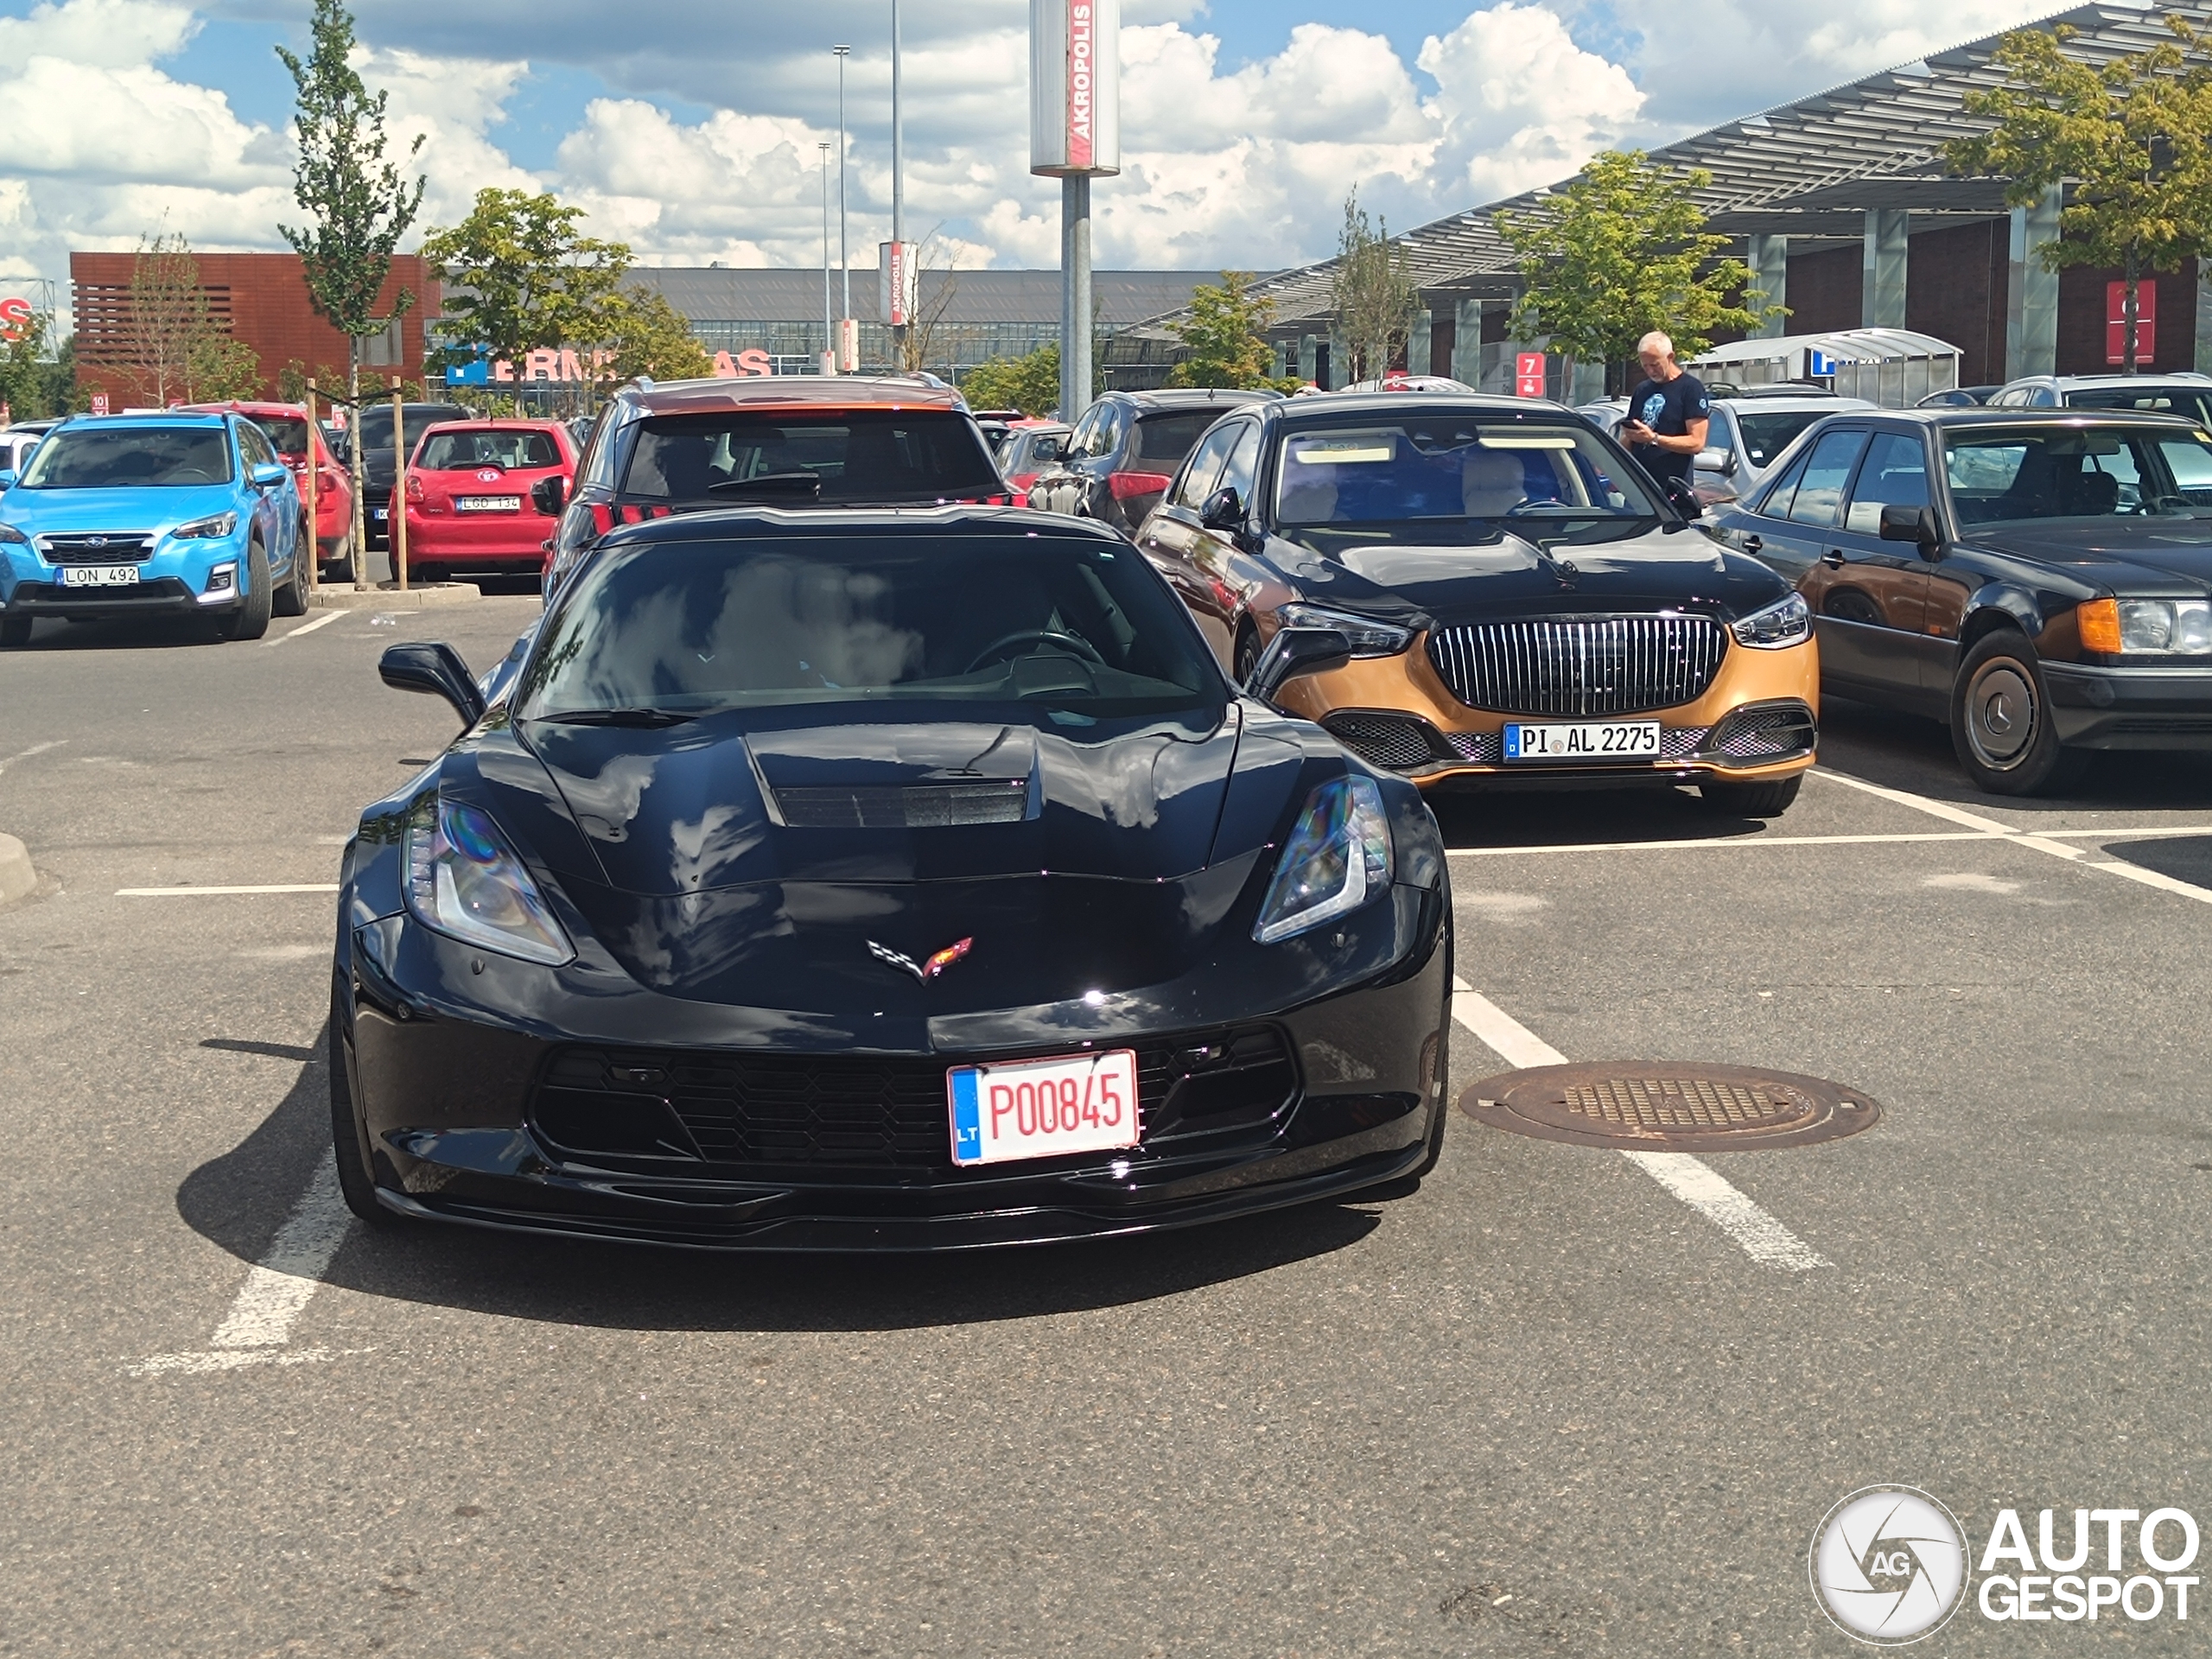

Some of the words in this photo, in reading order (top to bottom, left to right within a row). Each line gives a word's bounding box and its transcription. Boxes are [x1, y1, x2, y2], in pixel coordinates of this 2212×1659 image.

[1073, 4, 1090, 140] AKROPOLIS
[1523, 358, 1535, 374] 7
[92, 396, 104, 407] 10
[66, 569, 98, 582] LON
[109, 568, 137, 582] 492
[1522, 729, 1548, 753] PI
[1567, 728, 1595, 752] AL
[1601, 727, 1655, 751] 2275
[1509, 744, 1516, 753] D
[989, 1073, 1122, 1140] P00845
[957, 1127, 978, 1142] LT
